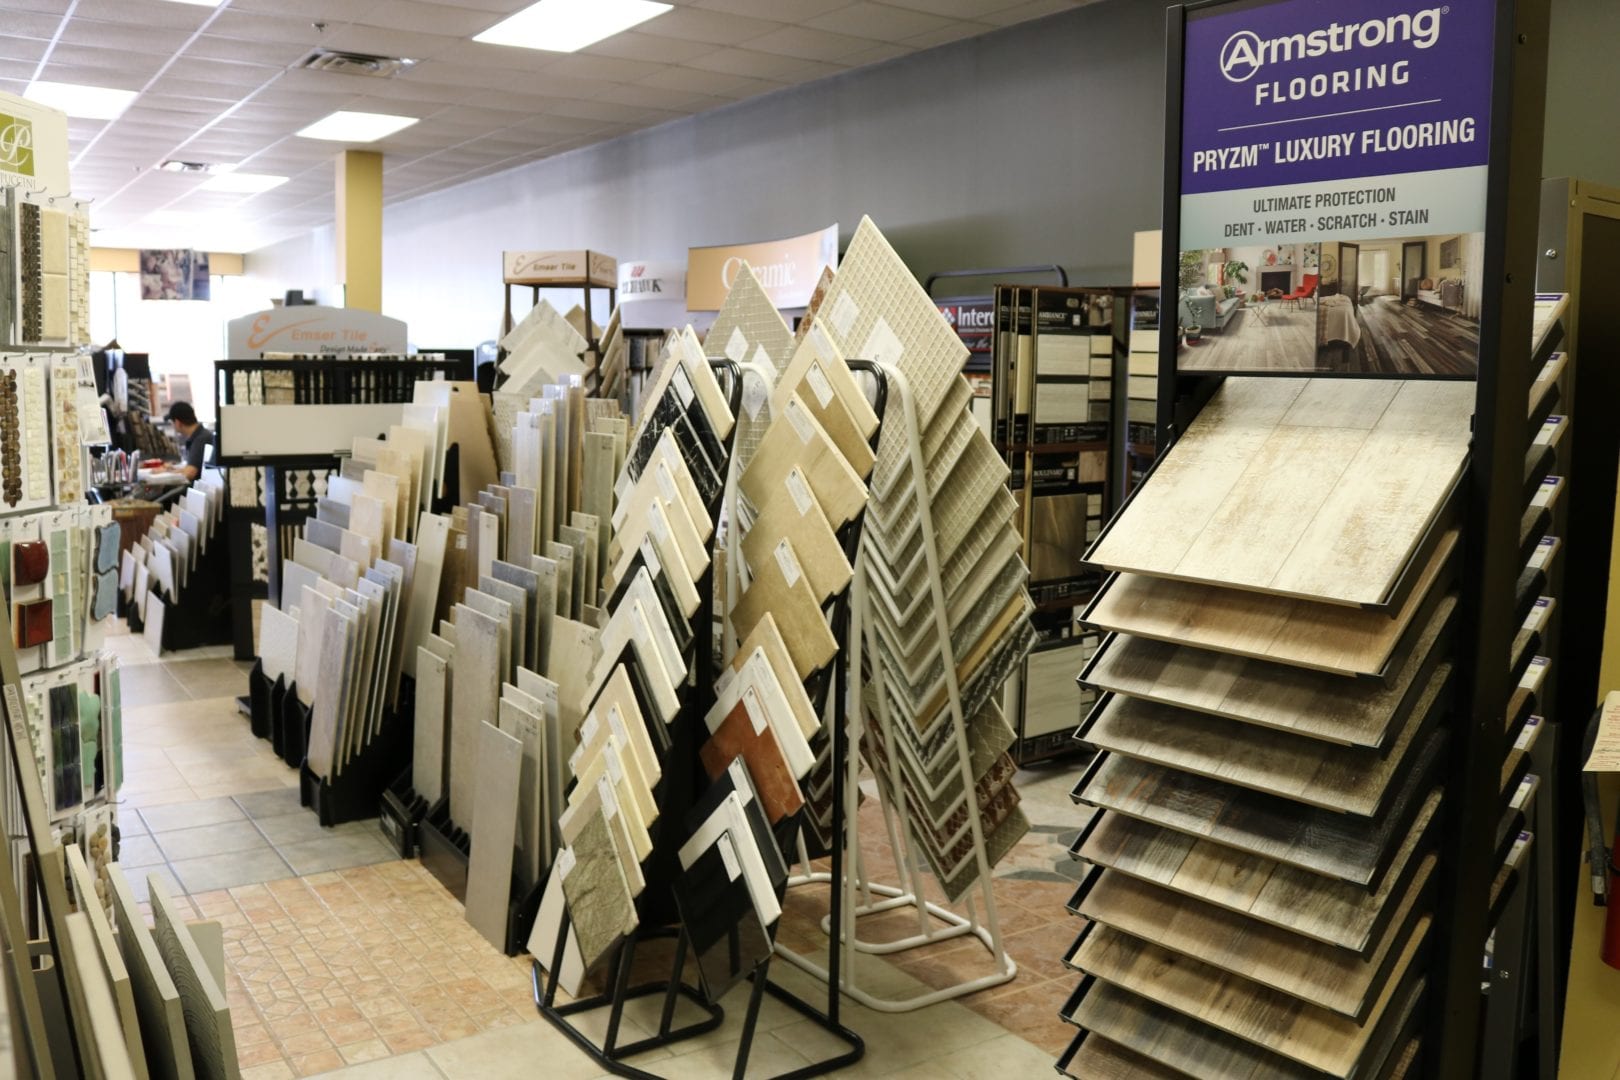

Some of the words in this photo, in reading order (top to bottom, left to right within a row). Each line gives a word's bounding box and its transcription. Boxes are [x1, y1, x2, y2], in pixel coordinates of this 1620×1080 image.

[1255, 60, 1409, 105] FLOORING
[1274, 133, 1355, 164] LUXURY
[1361, 117, 1476, 154] FLOORING
[1253, 195, 1312, 214] ULTIMATE
[1315, 187, 1396, 208] PROTECTION
[1224, 222, 1254, 238] DENT
[1265, 218, 1306, 235] WATER
[1317, 212, 1377, 232] SCRATCH
[1389, 208, 1429, 226] STAIN
[722, 253, 796, 290] Cramic
[291, 329, 336, 341] Emser
[342, 328, 369, 341] Tile
